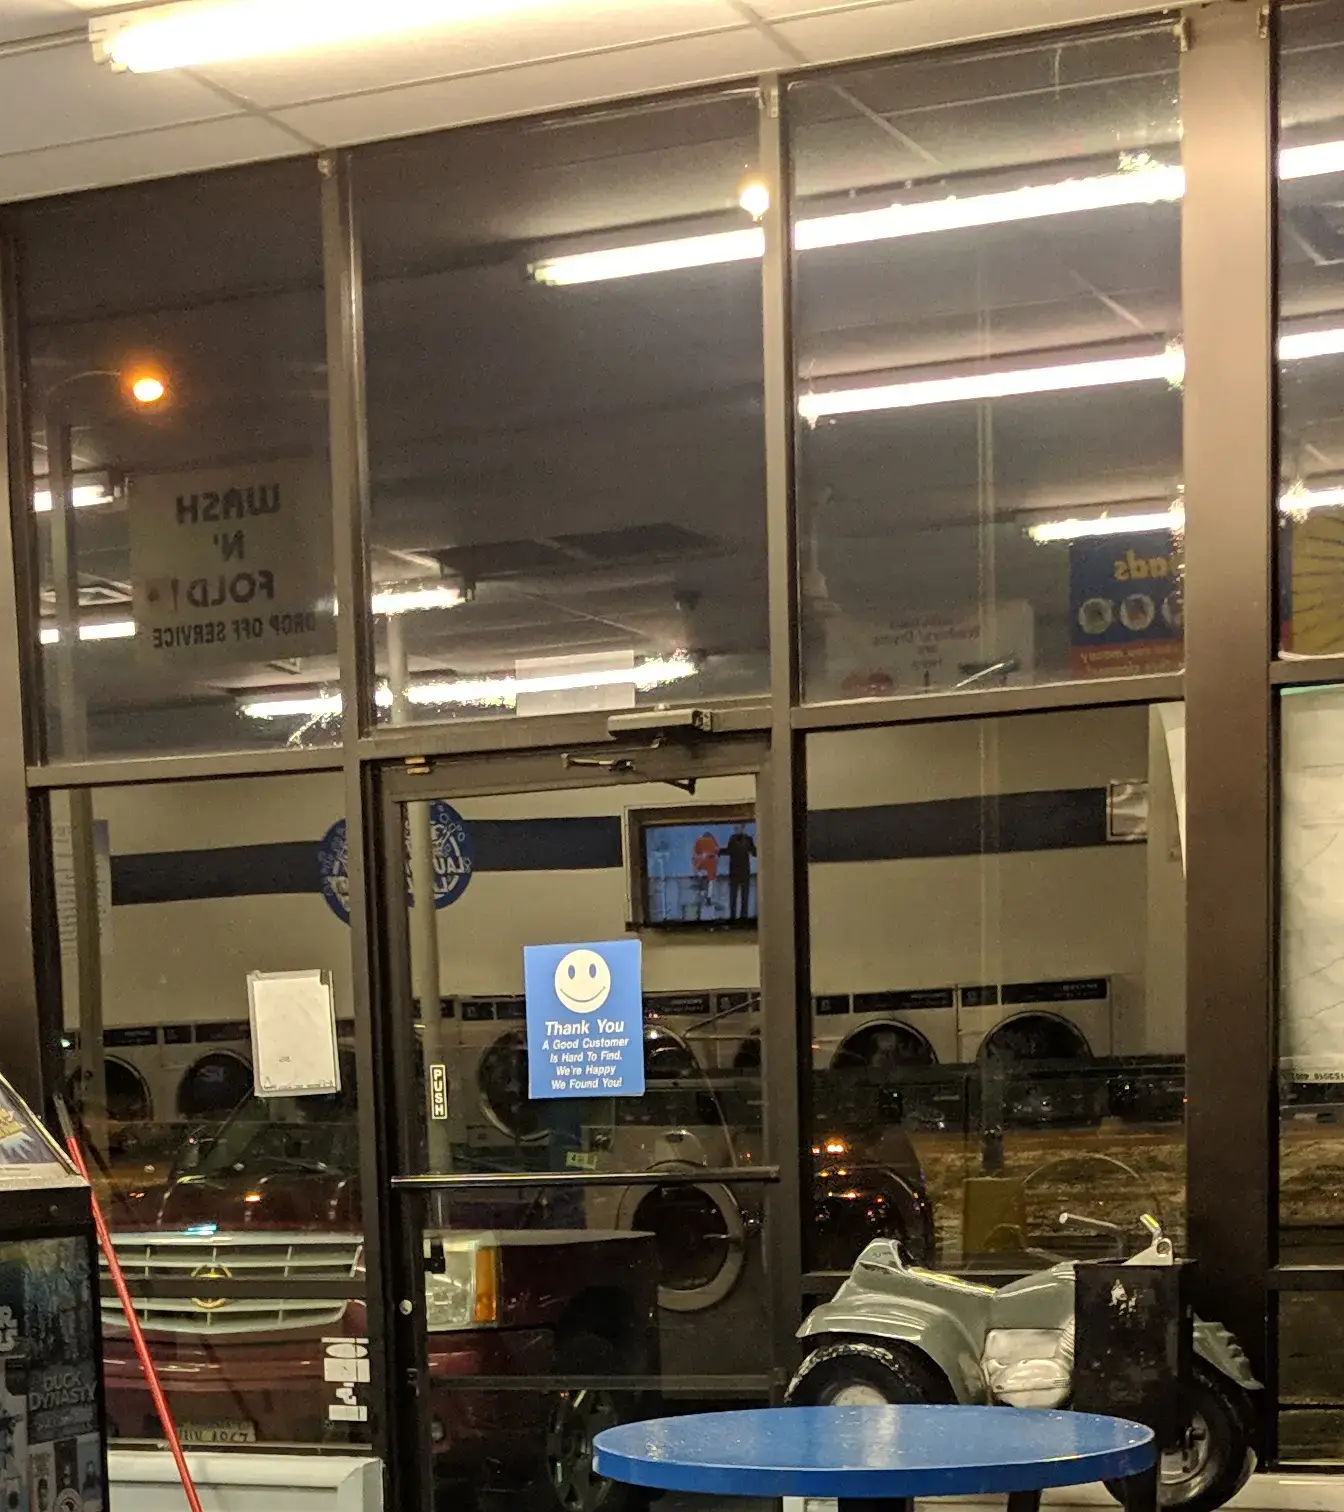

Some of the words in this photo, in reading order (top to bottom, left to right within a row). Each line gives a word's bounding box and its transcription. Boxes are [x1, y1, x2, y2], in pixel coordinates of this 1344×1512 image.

[545, 1020, 590, 1036] Thank
[597, 1019, 625, 1033] You
[542, 1040, 549, 1050] A
[553, 1038, 579, 1049] Good
[582, 1037, 629, 1049] Customer
[549, 1054, 558, 1063] Is
[561, 1052, 584, 1063] Hard
[587, 1051, 598, 1061] To
[556, 1065, 582, 1076] We're
[585, 1064, 616, 1077] Happy
[551, 1079, 566, 1090] We
[569, 1078, 599, 1089] Found
[602, 1077, 623, 1088] You!
[433, 1068, 444, 1116] PUSH
[43, 1372, 82, 1392] DUCK
[28, 1382, 97, 1411] DYNASTY
